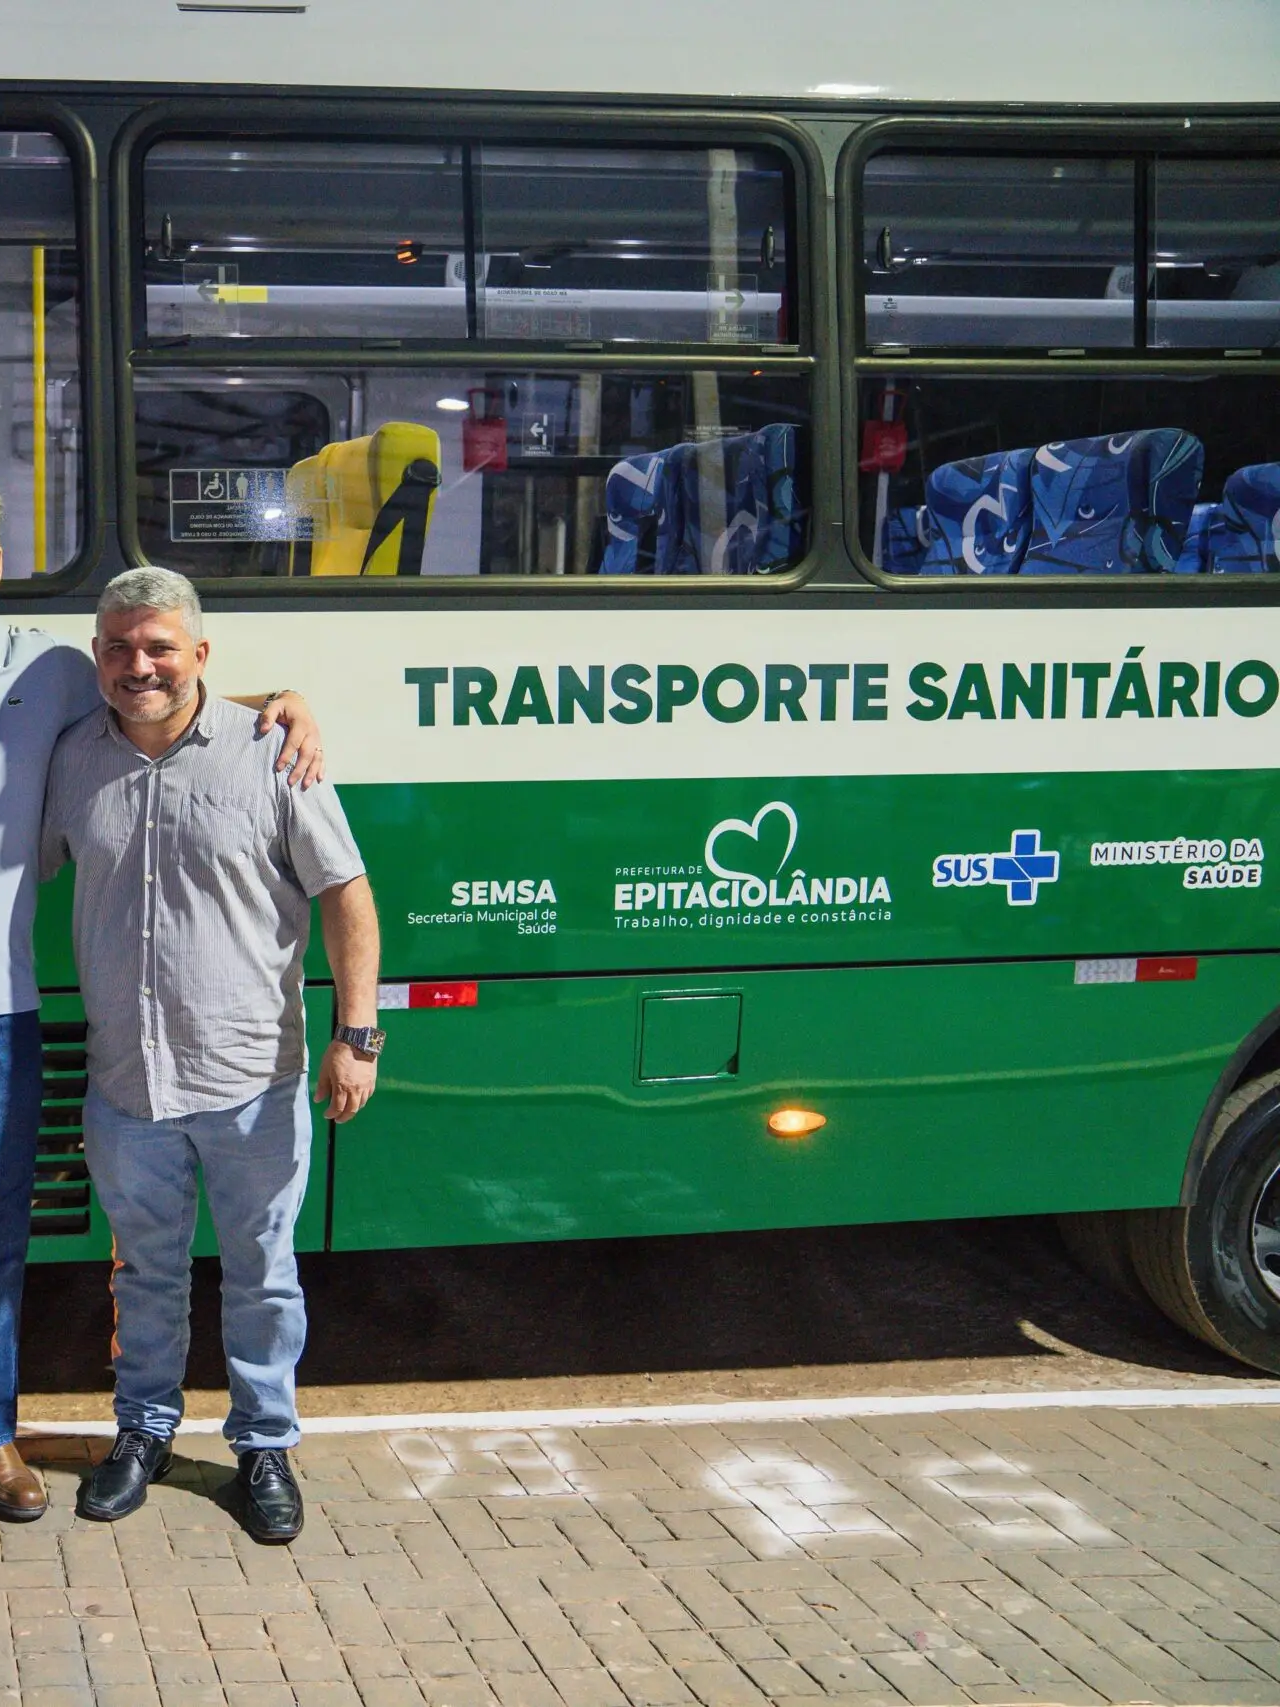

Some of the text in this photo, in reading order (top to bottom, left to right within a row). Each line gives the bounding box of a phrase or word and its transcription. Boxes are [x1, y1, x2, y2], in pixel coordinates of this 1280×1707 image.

[404, 646, 1280, 727] TRANSPORTE SANITÁRIO
[1093, 840, 1261, 862] MINISTÉRIO DA
[615, 865, 703, 876] PREFEITURA DE
[935, 857, 988, 883] SUS
[1186, 866, 1258, 885] SAÚDE
[451, 879, 557, 906] SEMSA
[614, 869, 892, 911] EPITACIOLÂNDIA
[407, 908, 557, 925] Secretaria Municipal de
[614, 908, 892, 929] Trabalho, dignidade e constância
[517, 921, 557, 935] Saúde
